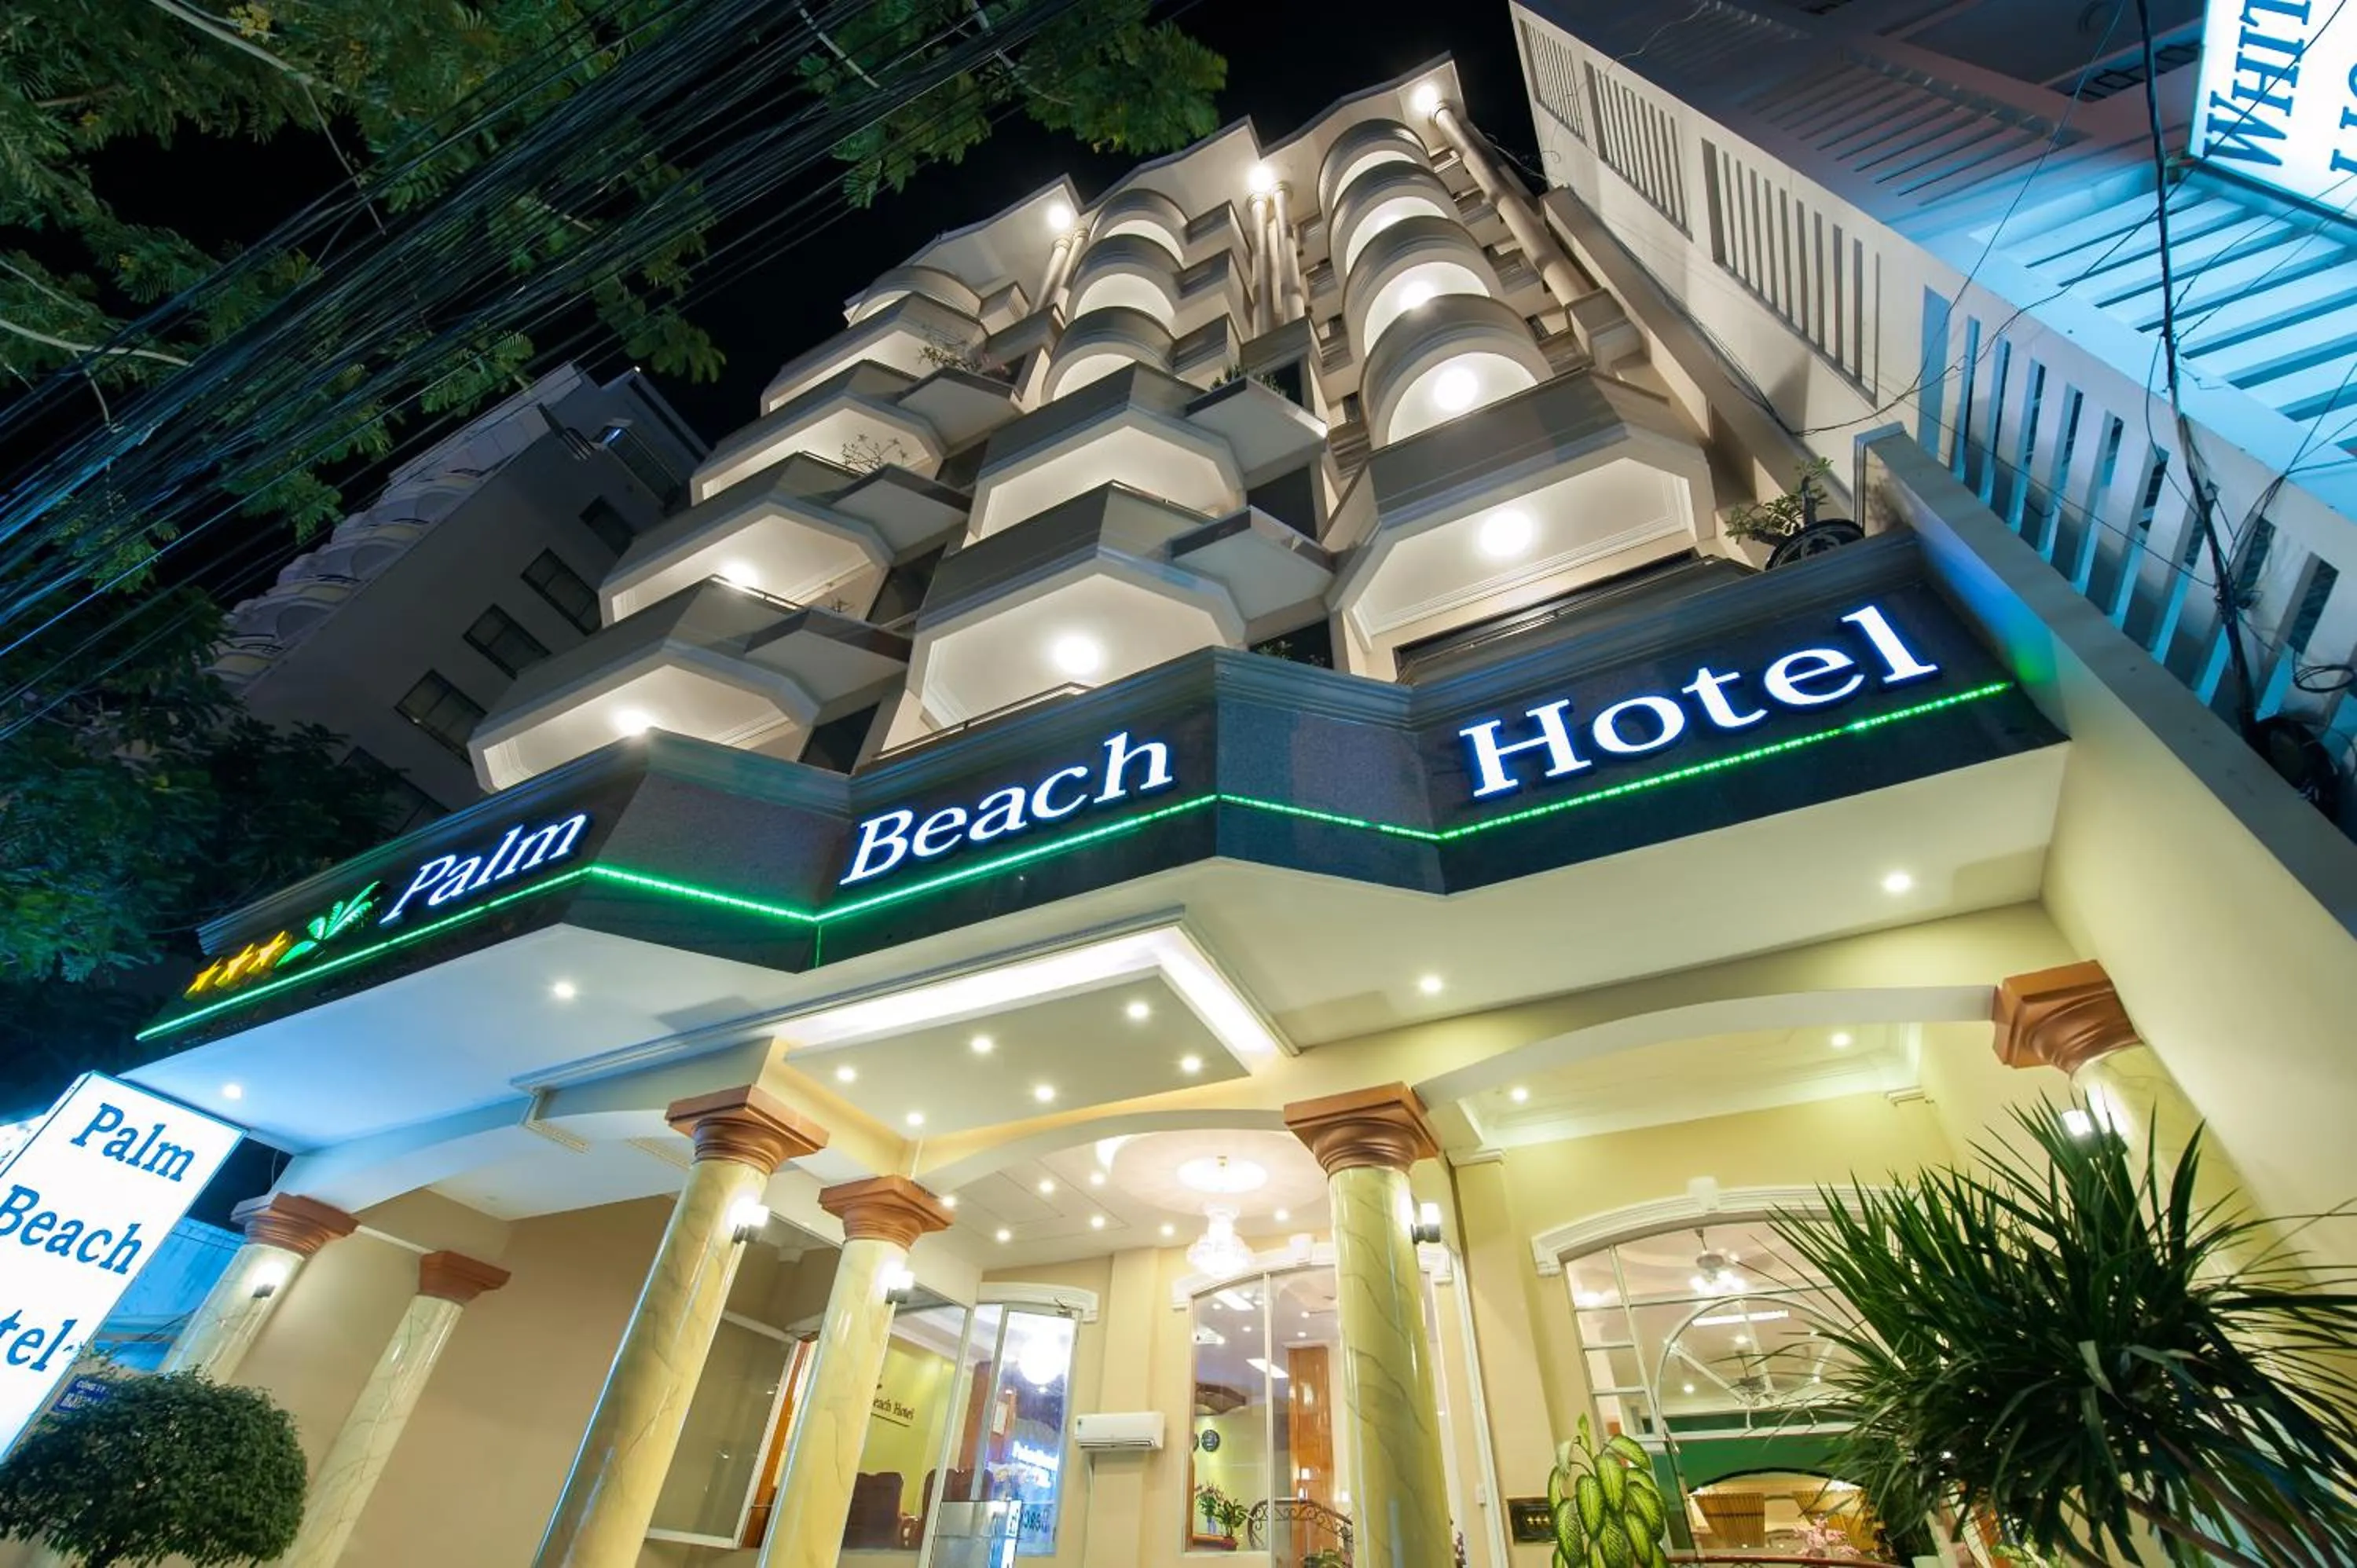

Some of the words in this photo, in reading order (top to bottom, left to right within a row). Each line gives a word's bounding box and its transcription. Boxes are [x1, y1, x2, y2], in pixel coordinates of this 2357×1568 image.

[379, 813, 588, 925] Palm
[840, 731, 1173, 885] Beach
[1459, 605, 1937, 798] Hotel
[70, 1102, 195, 1182] Palm
[0, 1184, 142, 1275] Beach
[873, 1398, 892, 1412] each
